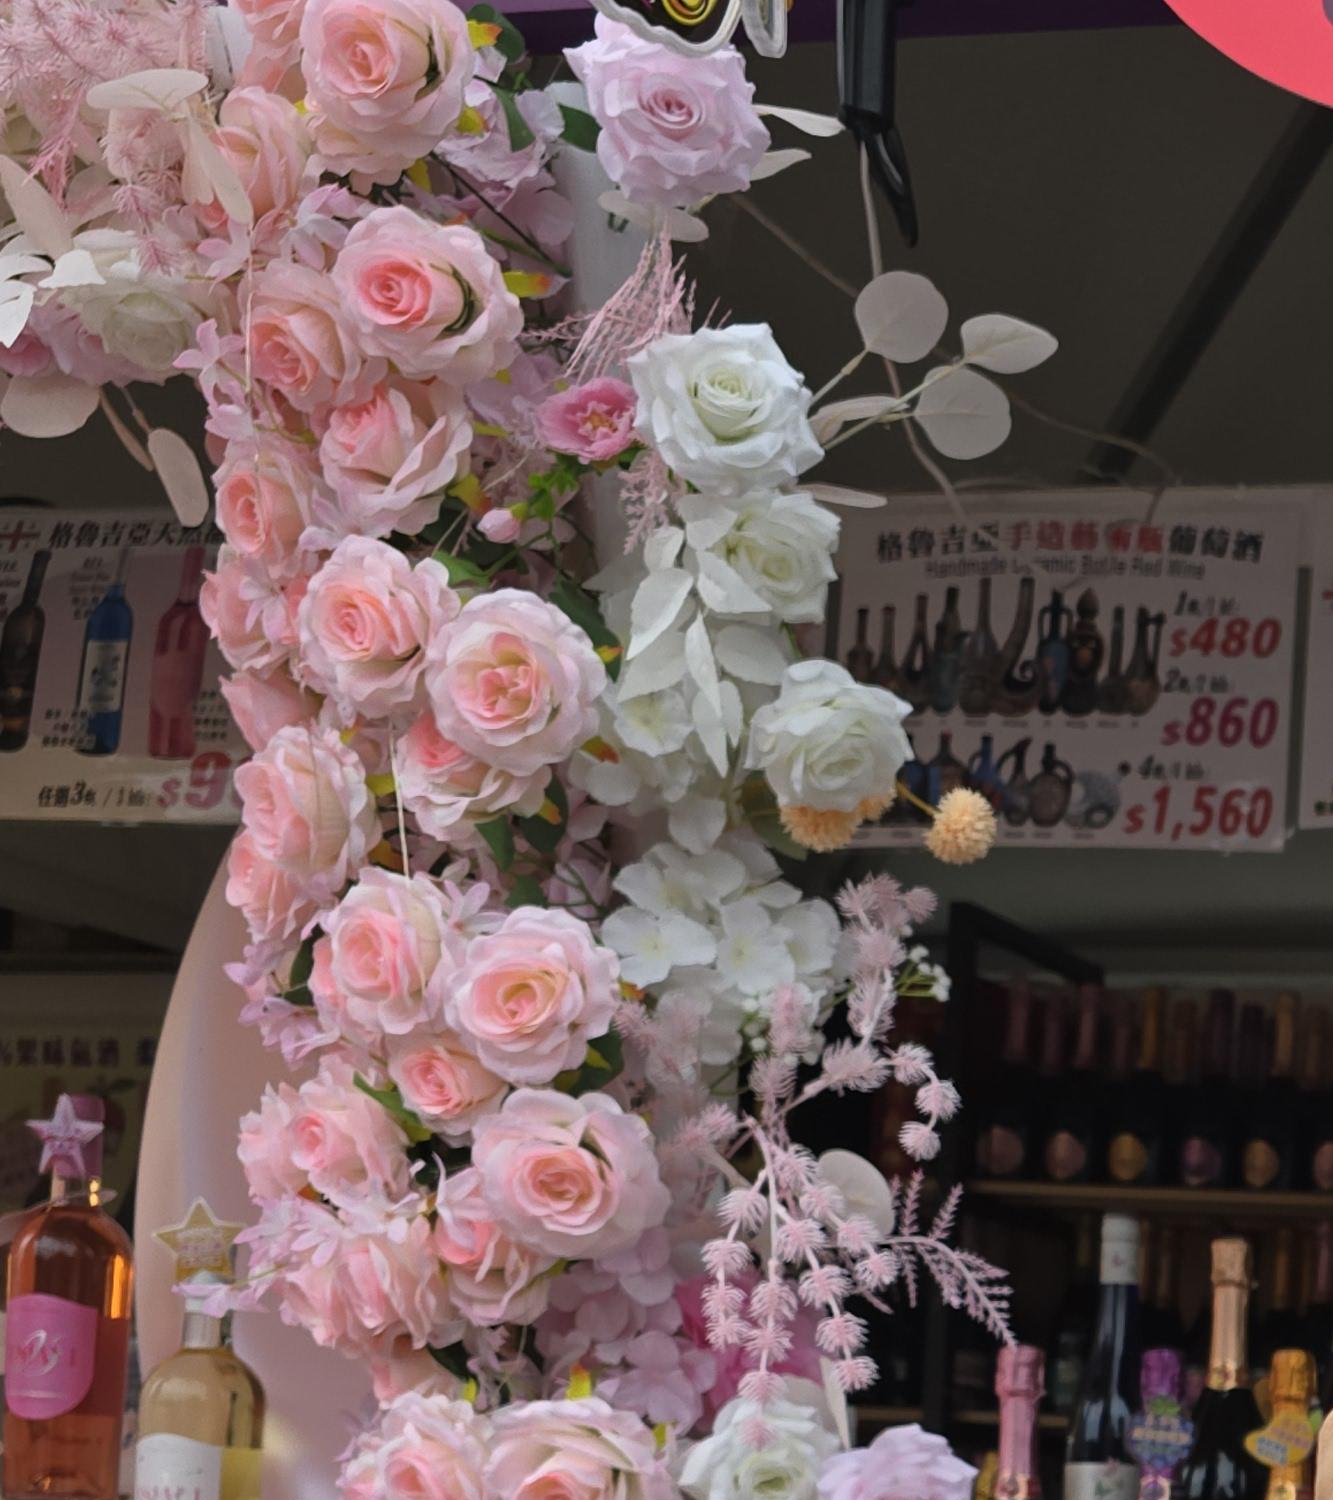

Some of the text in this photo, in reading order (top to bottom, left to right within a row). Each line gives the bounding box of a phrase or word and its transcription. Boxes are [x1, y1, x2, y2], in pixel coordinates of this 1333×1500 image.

[1168, 616, 1282, 659] $480
[1162, 696, 1279, 749] $860
[1124, 786, 1274, 842] $1,560
